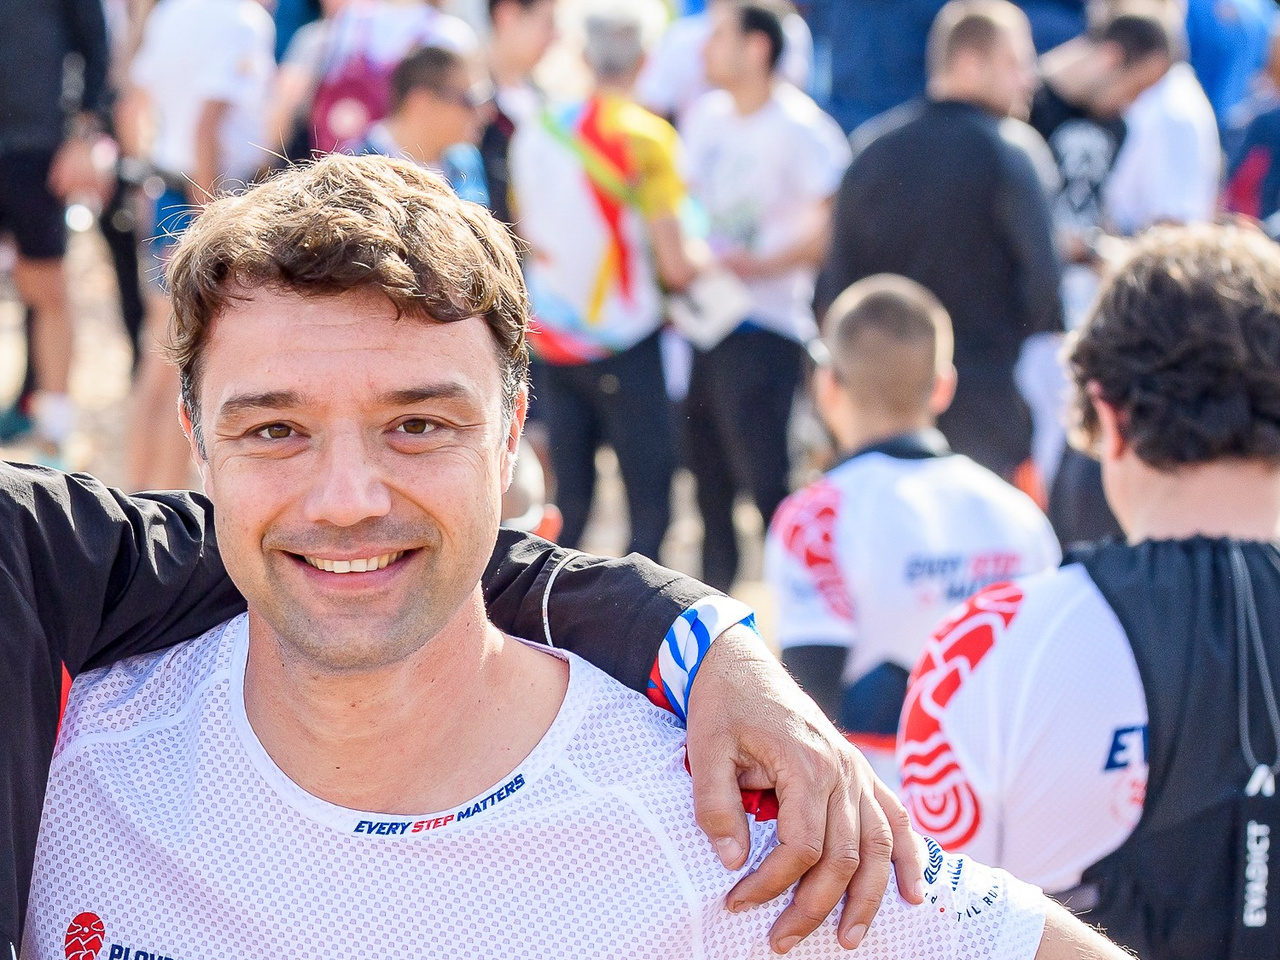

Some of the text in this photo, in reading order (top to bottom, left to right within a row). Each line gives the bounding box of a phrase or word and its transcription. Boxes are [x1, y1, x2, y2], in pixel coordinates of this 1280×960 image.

[353, 773, 526, 835] EVERY STEP MATTERS
